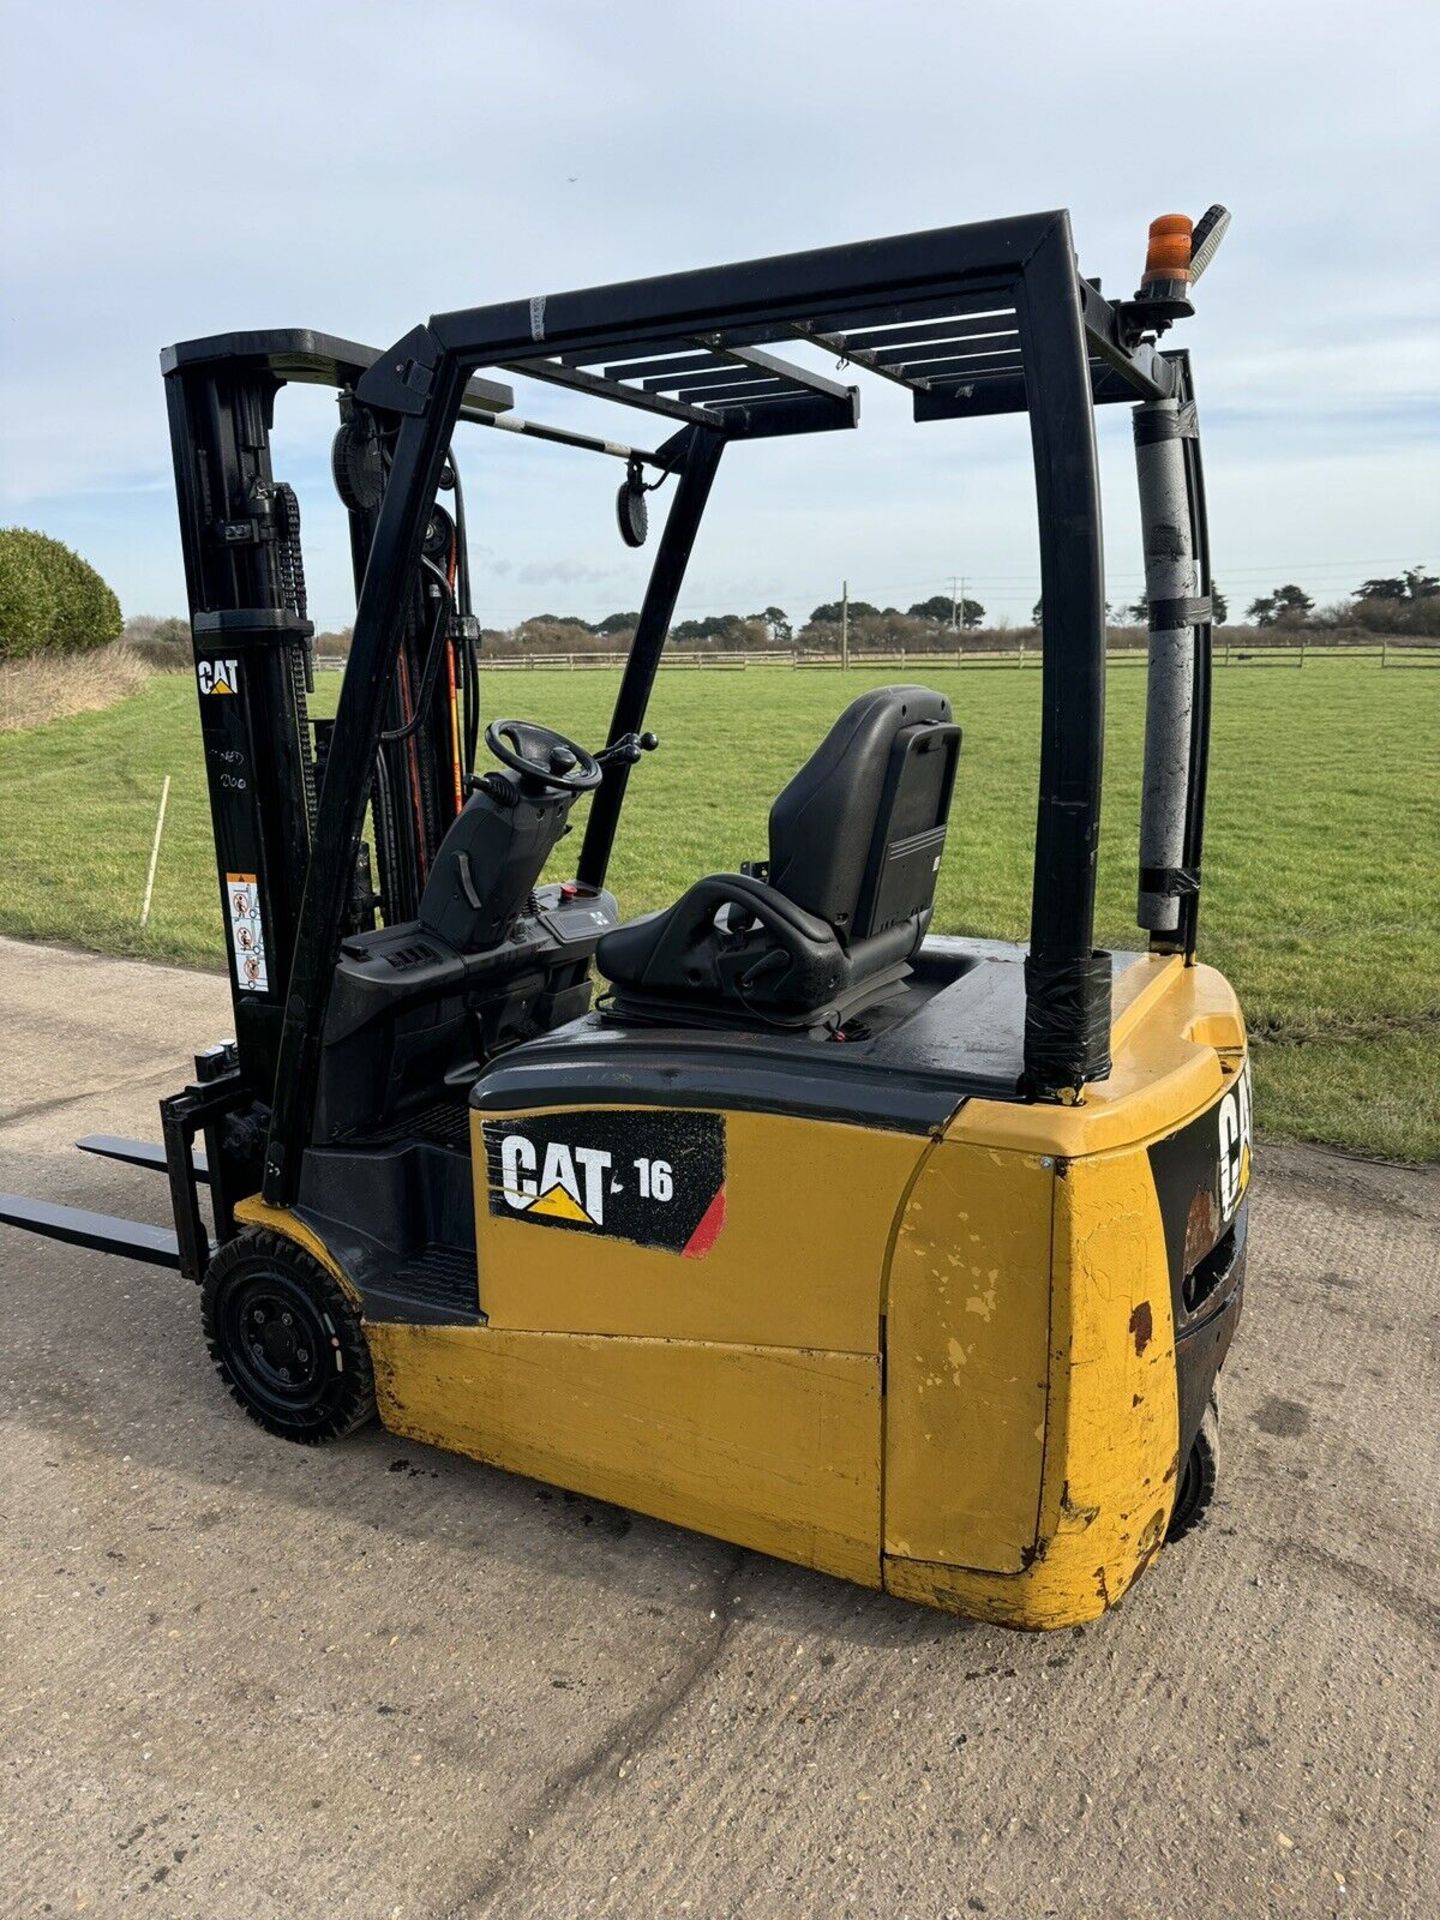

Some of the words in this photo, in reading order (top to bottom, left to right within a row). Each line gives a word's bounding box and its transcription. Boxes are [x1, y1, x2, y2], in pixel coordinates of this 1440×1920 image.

[198, 659, 238, 695] CAT
[500, 1134, 612, 1226] CAT
[633, 1157, 674, 1202] 16
